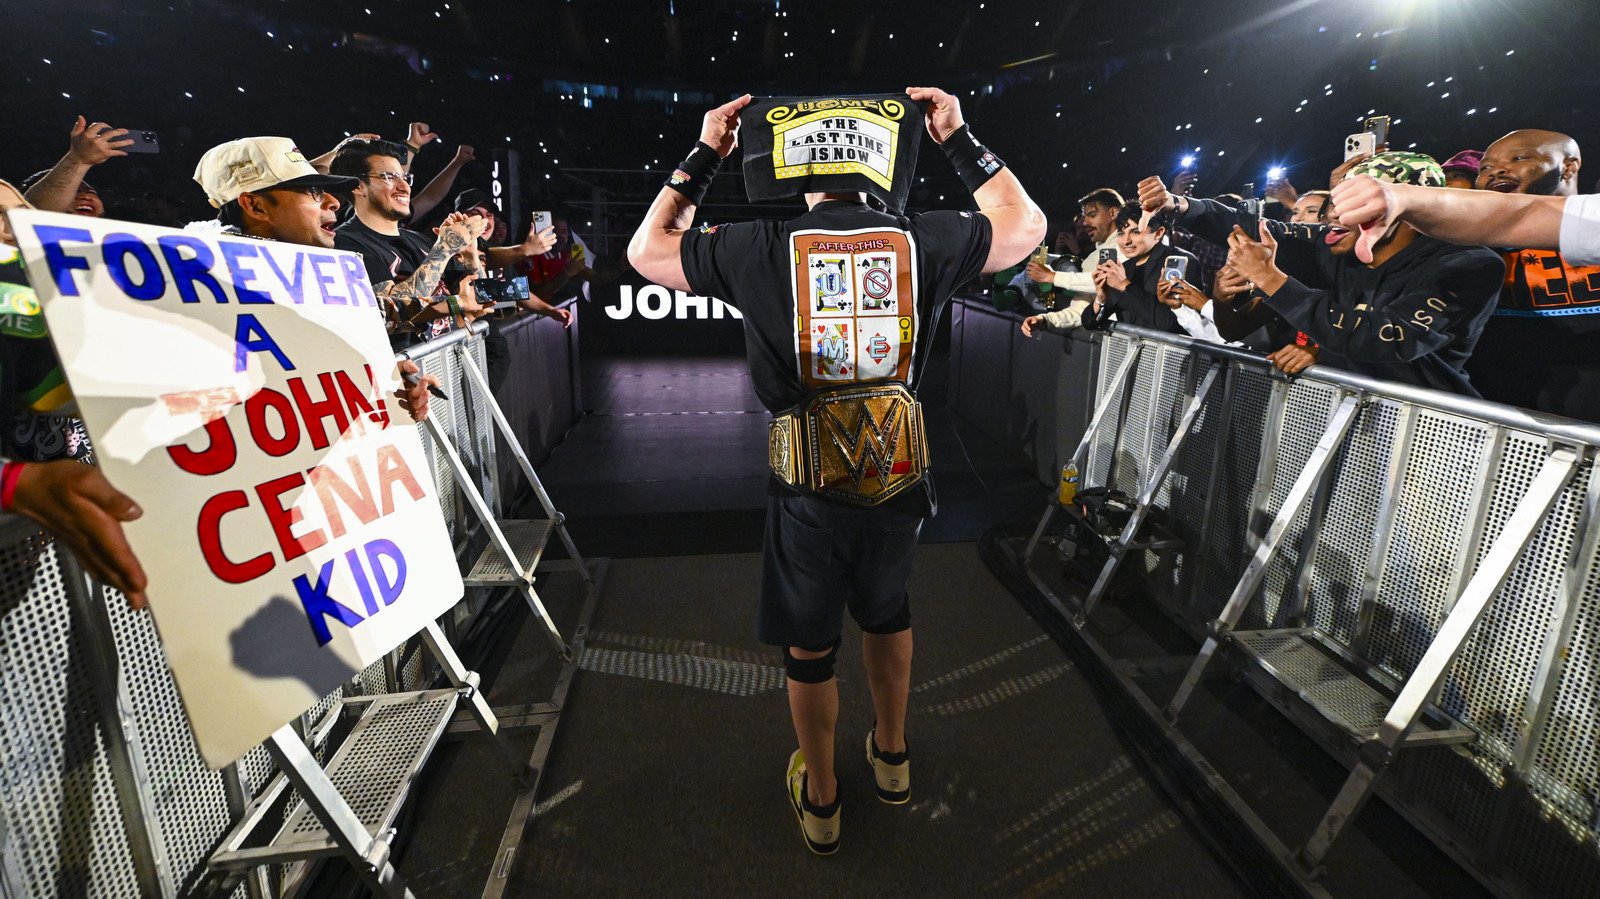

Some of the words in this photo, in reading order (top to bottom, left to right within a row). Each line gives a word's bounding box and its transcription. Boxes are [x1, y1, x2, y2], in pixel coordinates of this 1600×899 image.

[791, 132, 840, 146] LAST
[846, 133, 884, 155] TIME
[822, 118, 858, 131] THE
[811, 147, 829, 161] IS
[833, 147, 869, 163] NOW
[33, 224, 377, 308] FOREVER
[820, 272, 842, 296] U
[233, 313, 296, 373] A
[823, 337, 845, 361] M
[869, 336, 888, 359] E
[161, 363, 392, 476] JOHN
[196, 443, 427, 584] CENA
[292, 538, 408, 648] KID
